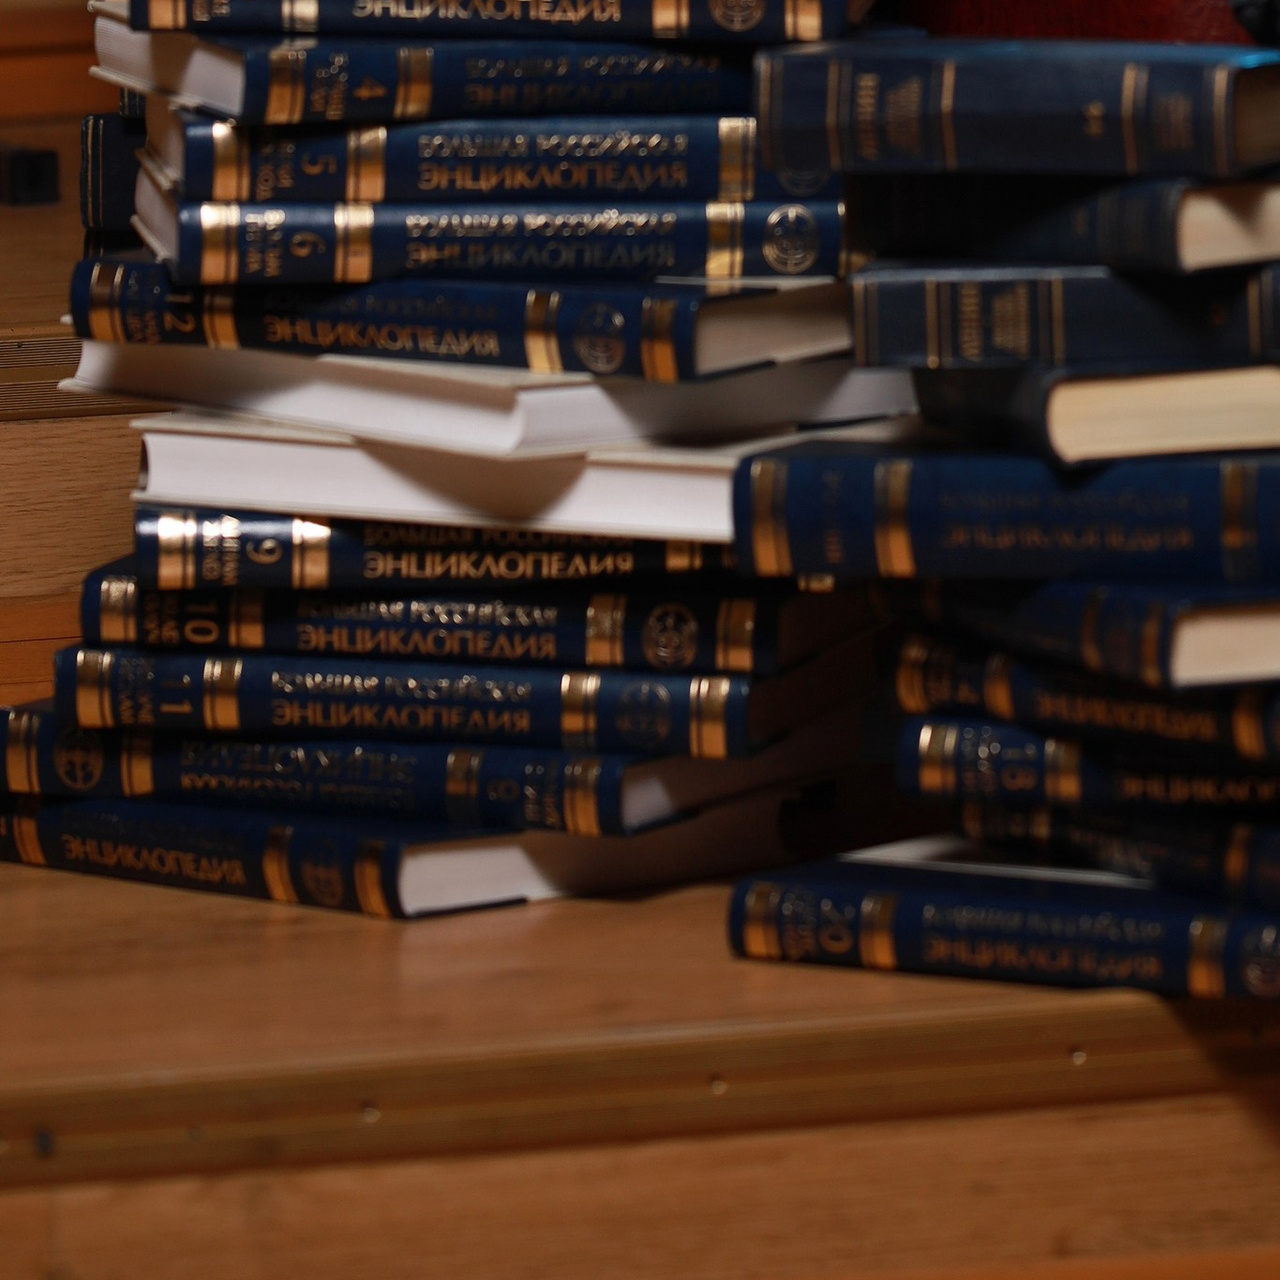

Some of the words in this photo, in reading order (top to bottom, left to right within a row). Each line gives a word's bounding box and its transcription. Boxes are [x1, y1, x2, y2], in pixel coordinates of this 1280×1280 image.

[352, 74, 389, 102] 4
[301, 151, 338, 177] 5
[416, 160, 689, 192] ЭНЦИКЛОПЕДИЯ
[289, 230, 327, 258] 6
[404, 241, 676, 269] ЭНЦИКЛОПЕДИЯ
[162, 290, 197, 334] 12
[262, 313, 500, 358] ЭНЦИКЛОПЕДИЯ
[245, 537, 284, 565] 9
[361, 550, 635, 581] ЭНЦИКЛОПЕДИЯ
[183, 602, 220, 646] 10
[295, 624, 558, 660] ЭНЦИКЛОПЕДИЯ
[159, 673, 194, 715] 11
[271, 698, 532, 734] ЭНЦИКЛОПЕДИЯ
[58, 833, 248, 887] ЭНЦИКЛОПЕДИЯ
